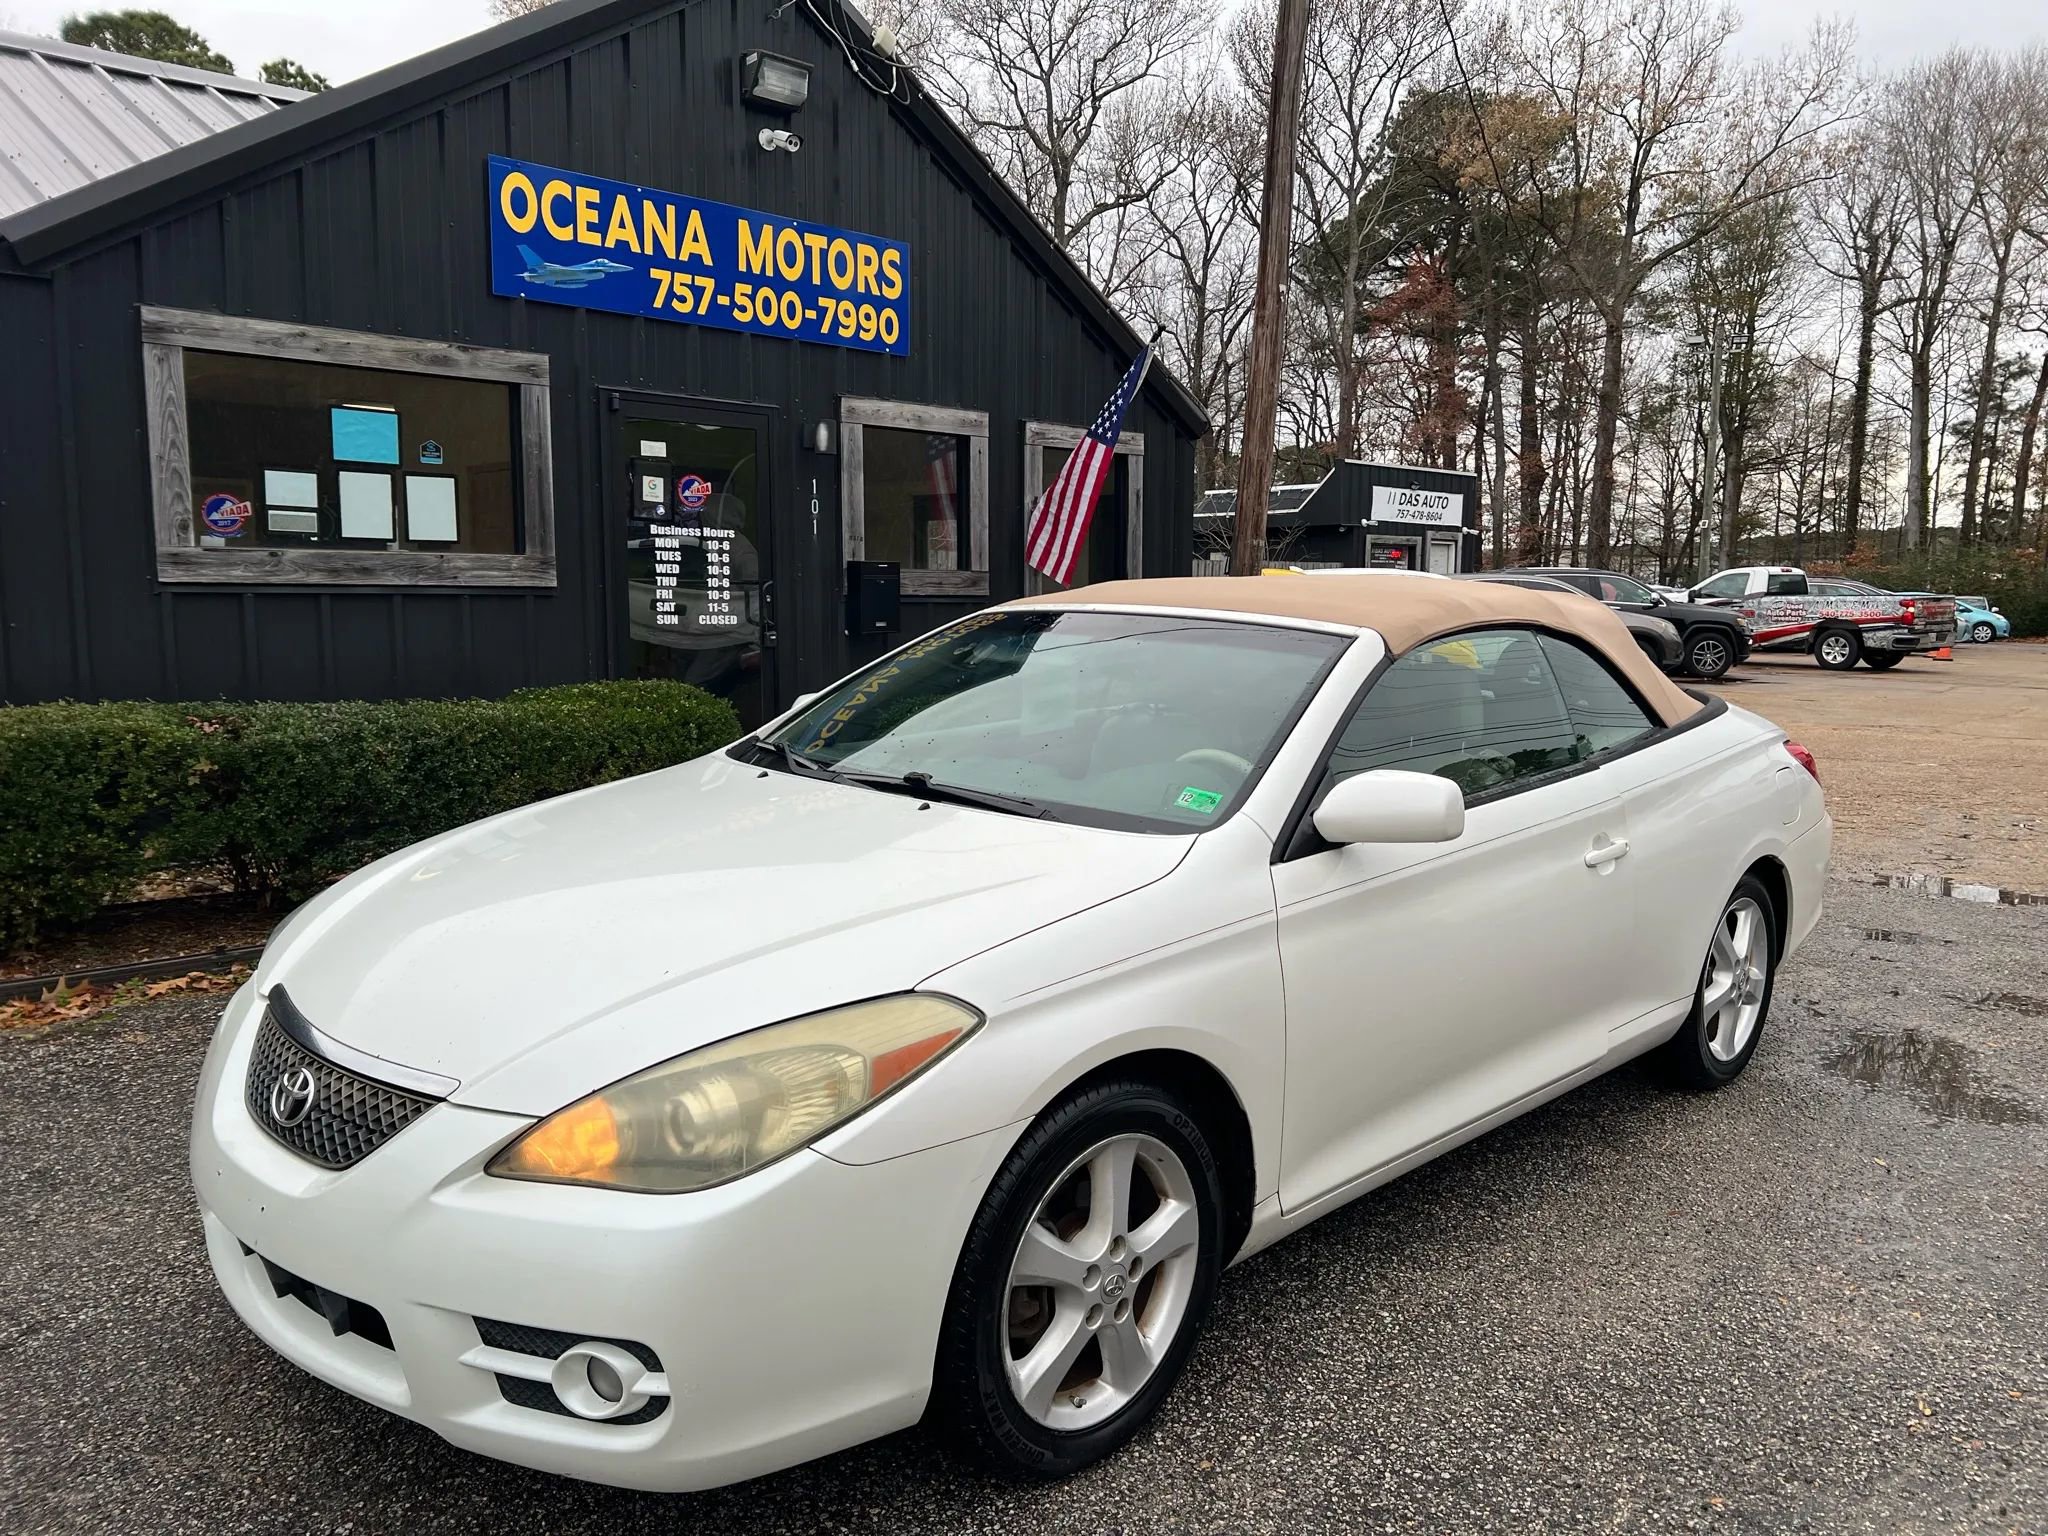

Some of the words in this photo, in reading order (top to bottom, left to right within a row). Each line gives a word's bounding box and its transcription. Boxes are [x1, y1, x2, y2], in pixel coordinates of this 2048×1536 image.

[501, 171, 713, 266] OCEANA
[738, 218, 903, 300] MOTORS
[650, 267, 900, 345] 757-500-7990
[811, 478, 819, 535] 101
[1398, 493, 1421, 507] DAS
[1421, 494, 1450, 510] AUTO
[219, 503, 250, 517] VIADA
[1396, 509, 1443, 522] 757-478-8604
[650, 525, 702, 537] Business
[703, 527, 736, 539] Hours
[655, 538, 680, 549] MON
[706, 541, 731, 551] 10-6
[655, 551, 682, 562] TUES
[706, 553, 730, 563] 10-6
[655, 564, 680, 574] WED
[706, 565, 731, 576] 10-6
[655, 577, 677, 587] THU
[706, 578, 730, 588] 10-6
[655, 589, 673, 600] FRI
[706, 590, 731, 601] 10-6
[656, 602, 677, 612] SAT
[707, 603, 729, 613] 11-5
[656, 614, 679, 625] SUN
[698, 614, 738, 625] CLOSED
[1180, 792, 1194, 803] 12
